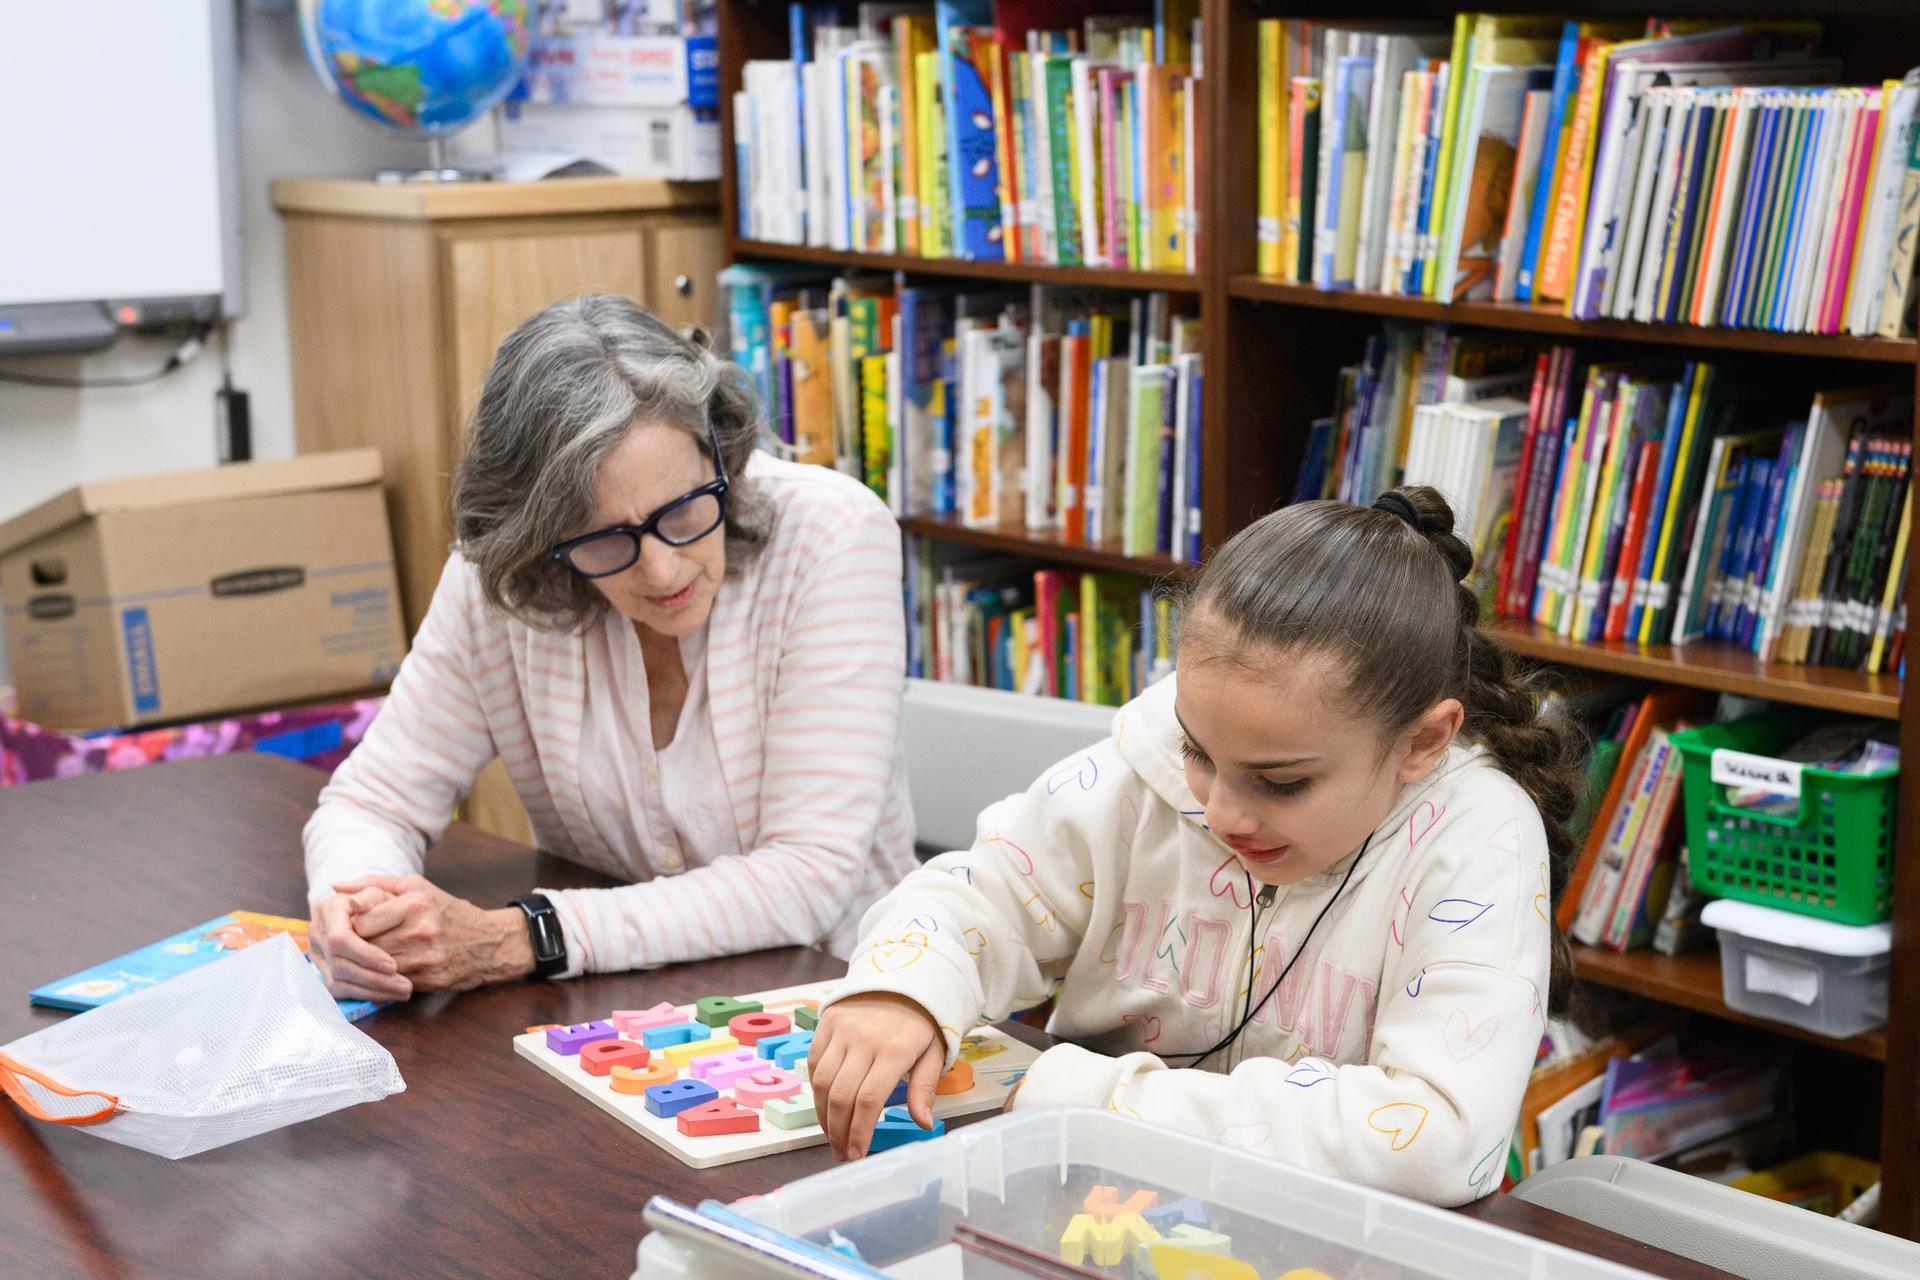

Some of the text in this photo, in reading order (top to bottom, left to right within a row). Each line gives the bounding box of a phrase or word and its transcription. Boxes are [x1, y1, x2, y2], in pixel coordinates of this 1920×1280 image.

[1544, 192, 1576, 283] Children
[612, 1001, 689, 1040] K
[695, 996, 763, 1028] P
[728, 1012, 791, 1047] O
[546, 1020, 760, 1137] A B C D E
[690, 1050, 771, 1089] H
